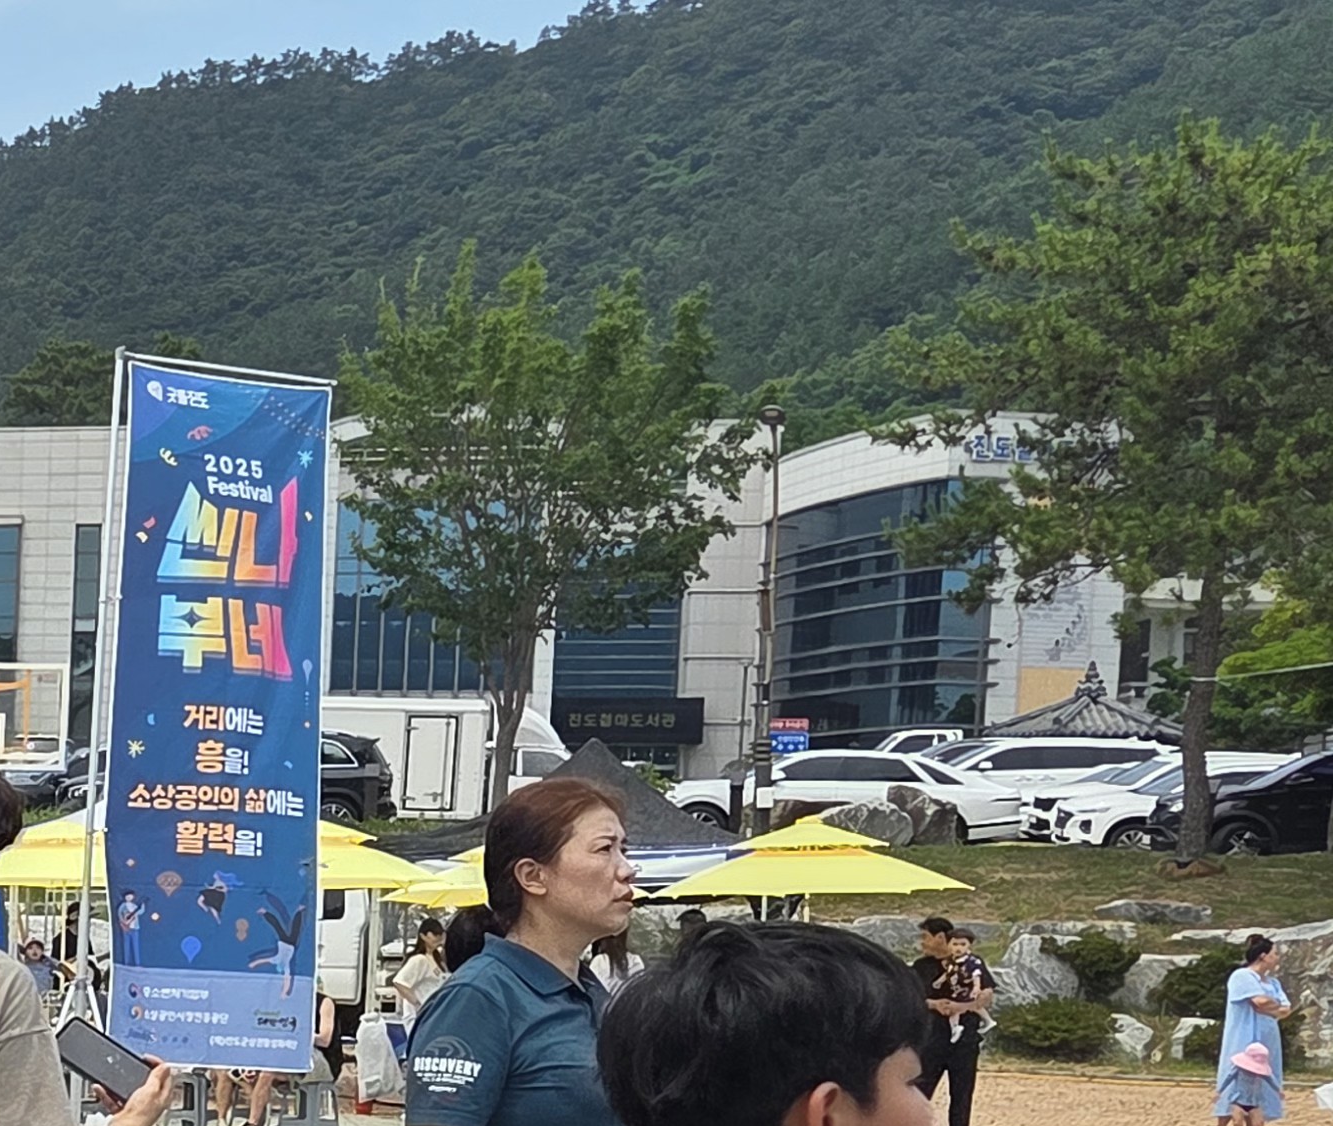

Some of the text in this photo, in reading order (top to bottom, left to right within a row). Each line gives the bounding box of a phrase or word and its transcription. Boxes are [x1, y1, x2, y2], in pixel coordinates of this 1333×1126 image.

[204, 454, 264, 479] 2025
[206, 475, 273, 504] Festival
[183, 704, 264, 735] 거리에는
[195, 739, 250, 775] 흥을!
[127, 783, 304, 818] 소상공인의 삶에는
[175, 820, 264, 857] 활력을!
[413, 1056, 482, 1078] DISCOVERY
